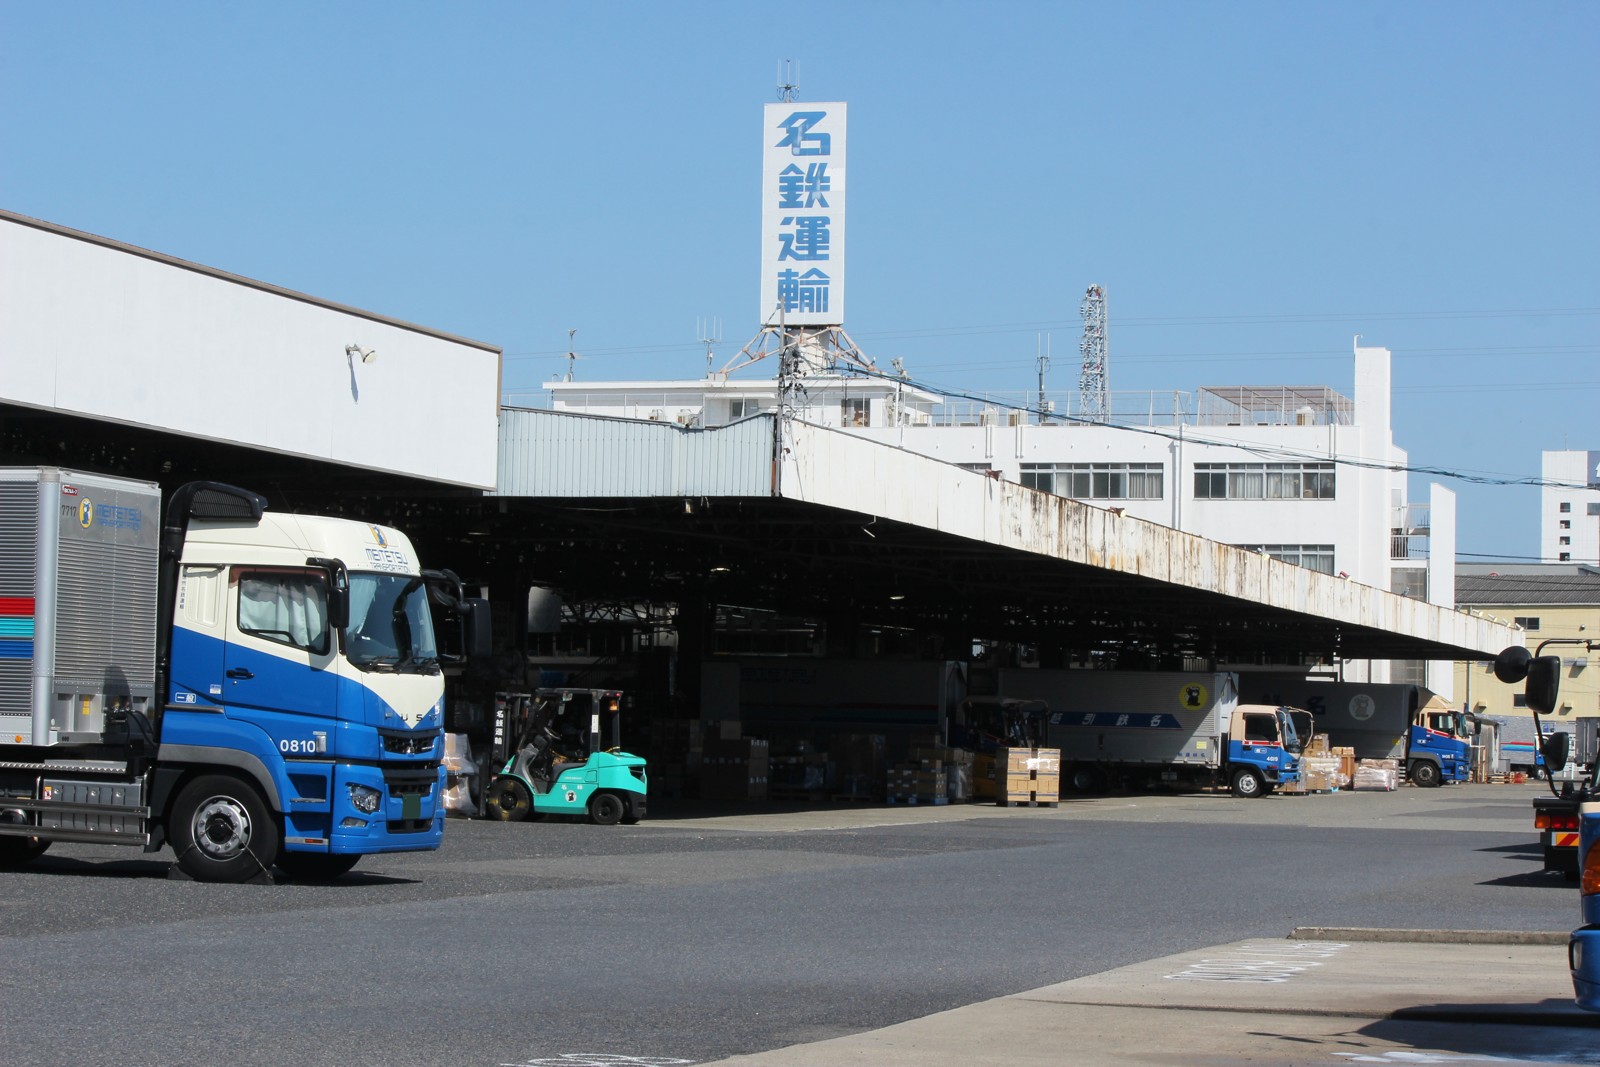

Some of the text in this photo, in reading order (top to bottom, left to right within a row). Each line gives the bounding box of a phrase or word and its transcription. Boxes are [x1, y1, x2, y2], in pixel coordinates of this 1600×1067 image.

[774, 111, 831, 313] 名鉄運輸
[365, 548, 408, 565] MEITETSU
[280, 739, 316, 752] 0810
